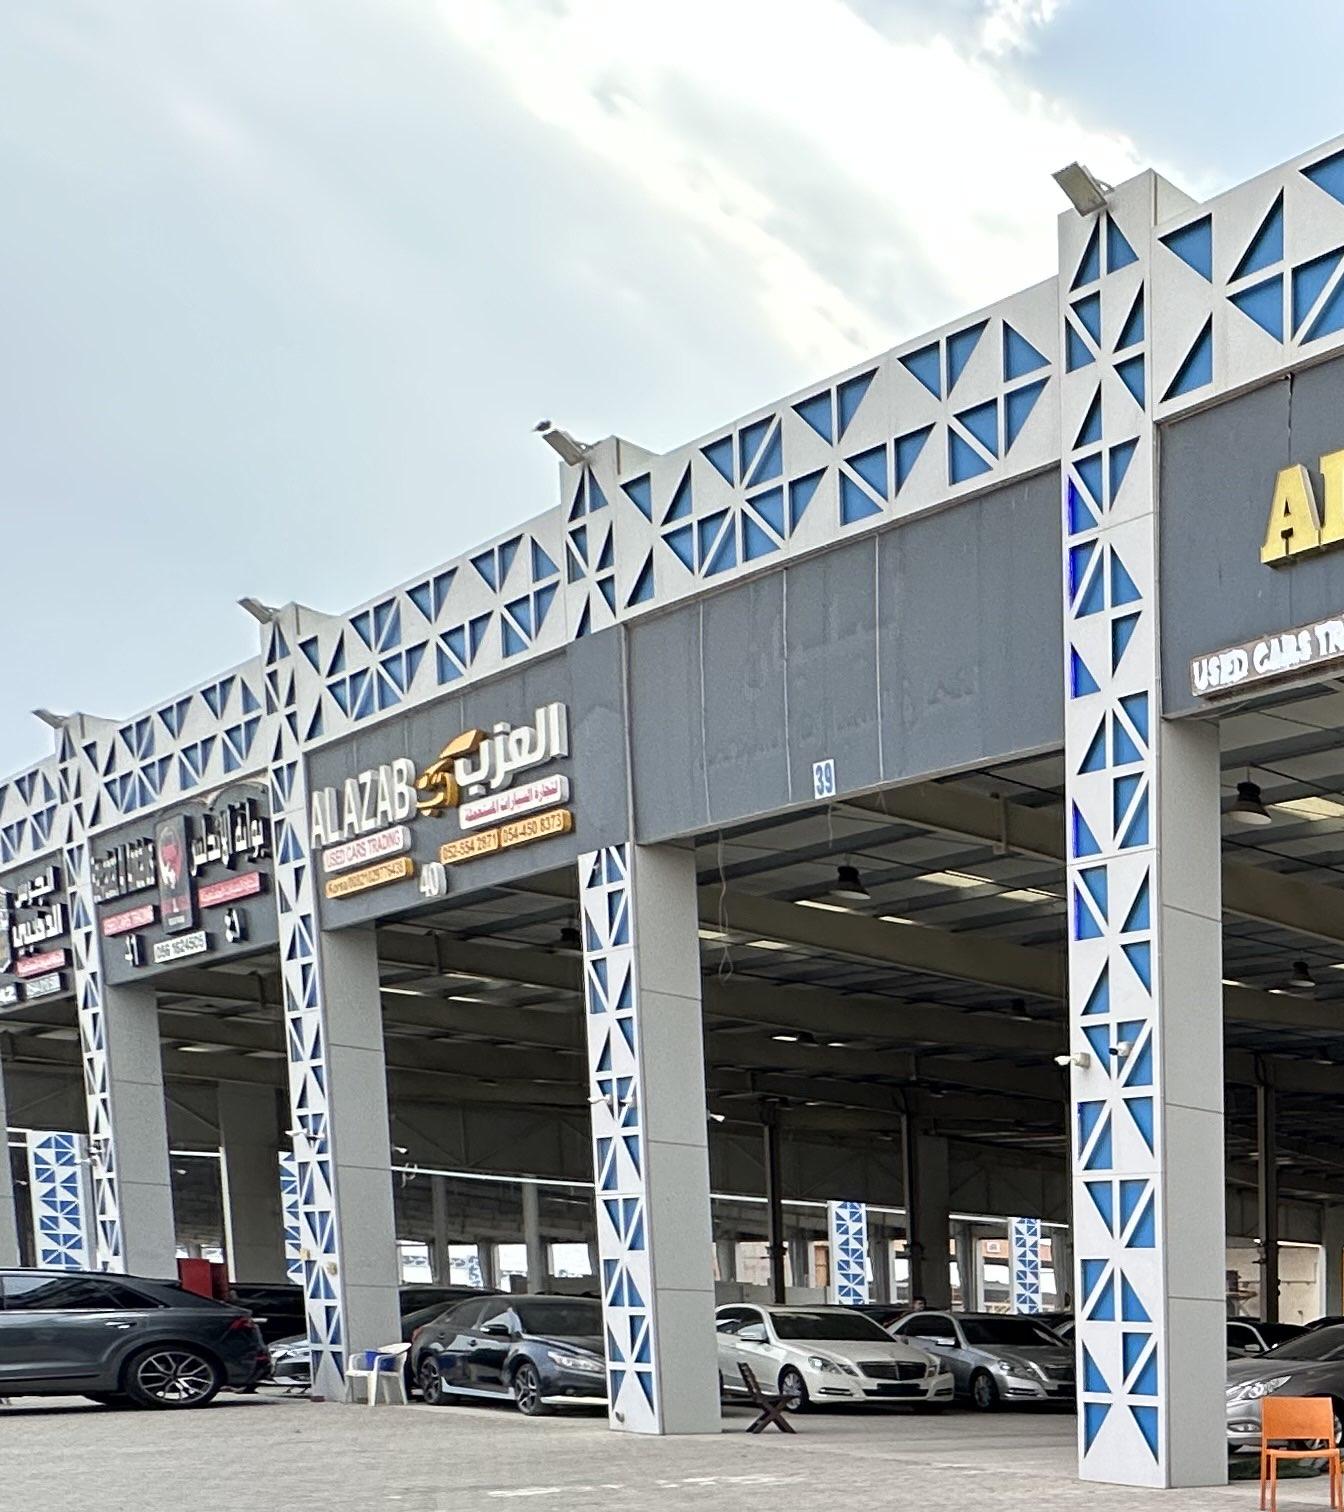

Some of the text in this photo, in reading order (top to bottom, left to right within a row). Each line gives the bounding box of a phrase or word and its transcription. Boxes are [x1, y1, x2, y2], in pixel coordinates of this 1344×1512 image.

[1192, 649, 1249, 691] USED
[1253, 626, 1313, 675] CARS
[815, 762, 833, 796] 39
[326, 829, 402, 868] USED CARS TRADING
[419, 862, 446, 897] 40
